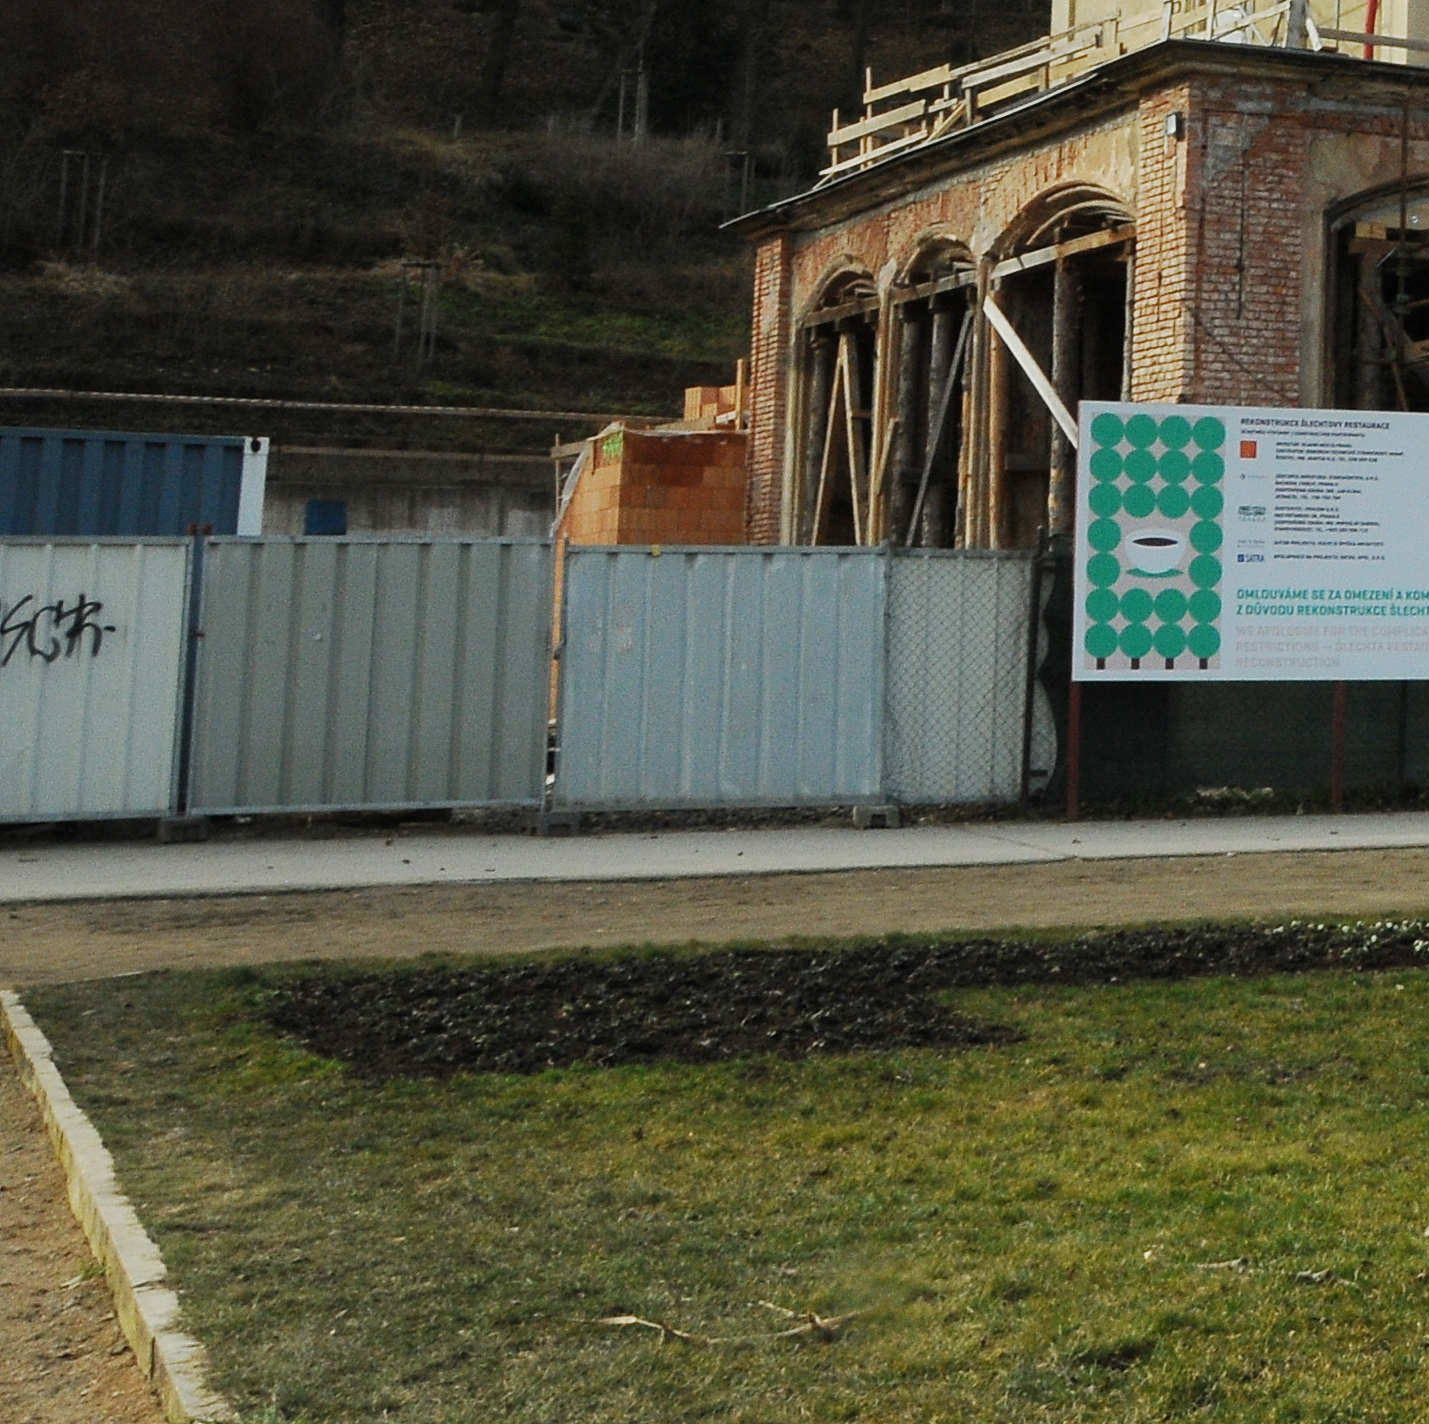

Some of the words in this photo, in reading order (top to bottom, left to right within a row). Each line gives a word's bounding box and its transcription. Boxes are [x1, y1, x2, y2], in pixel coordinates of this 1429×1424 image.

[1236, 586, 1309, 600] OMLOUVÁME
[1310, 589, 1325, 600] SE
[1327, 589, 1341, 600] ZA
[1344, 588, 1394, 601] OMEZENÍ
[1395, 591, 1403, 601] A
[1236, 604, 1243, 615] Z
[1245, 602, 1294, 615] DŮVODU
[1297, 605, 1387, 616] REKONSTRUKCE
